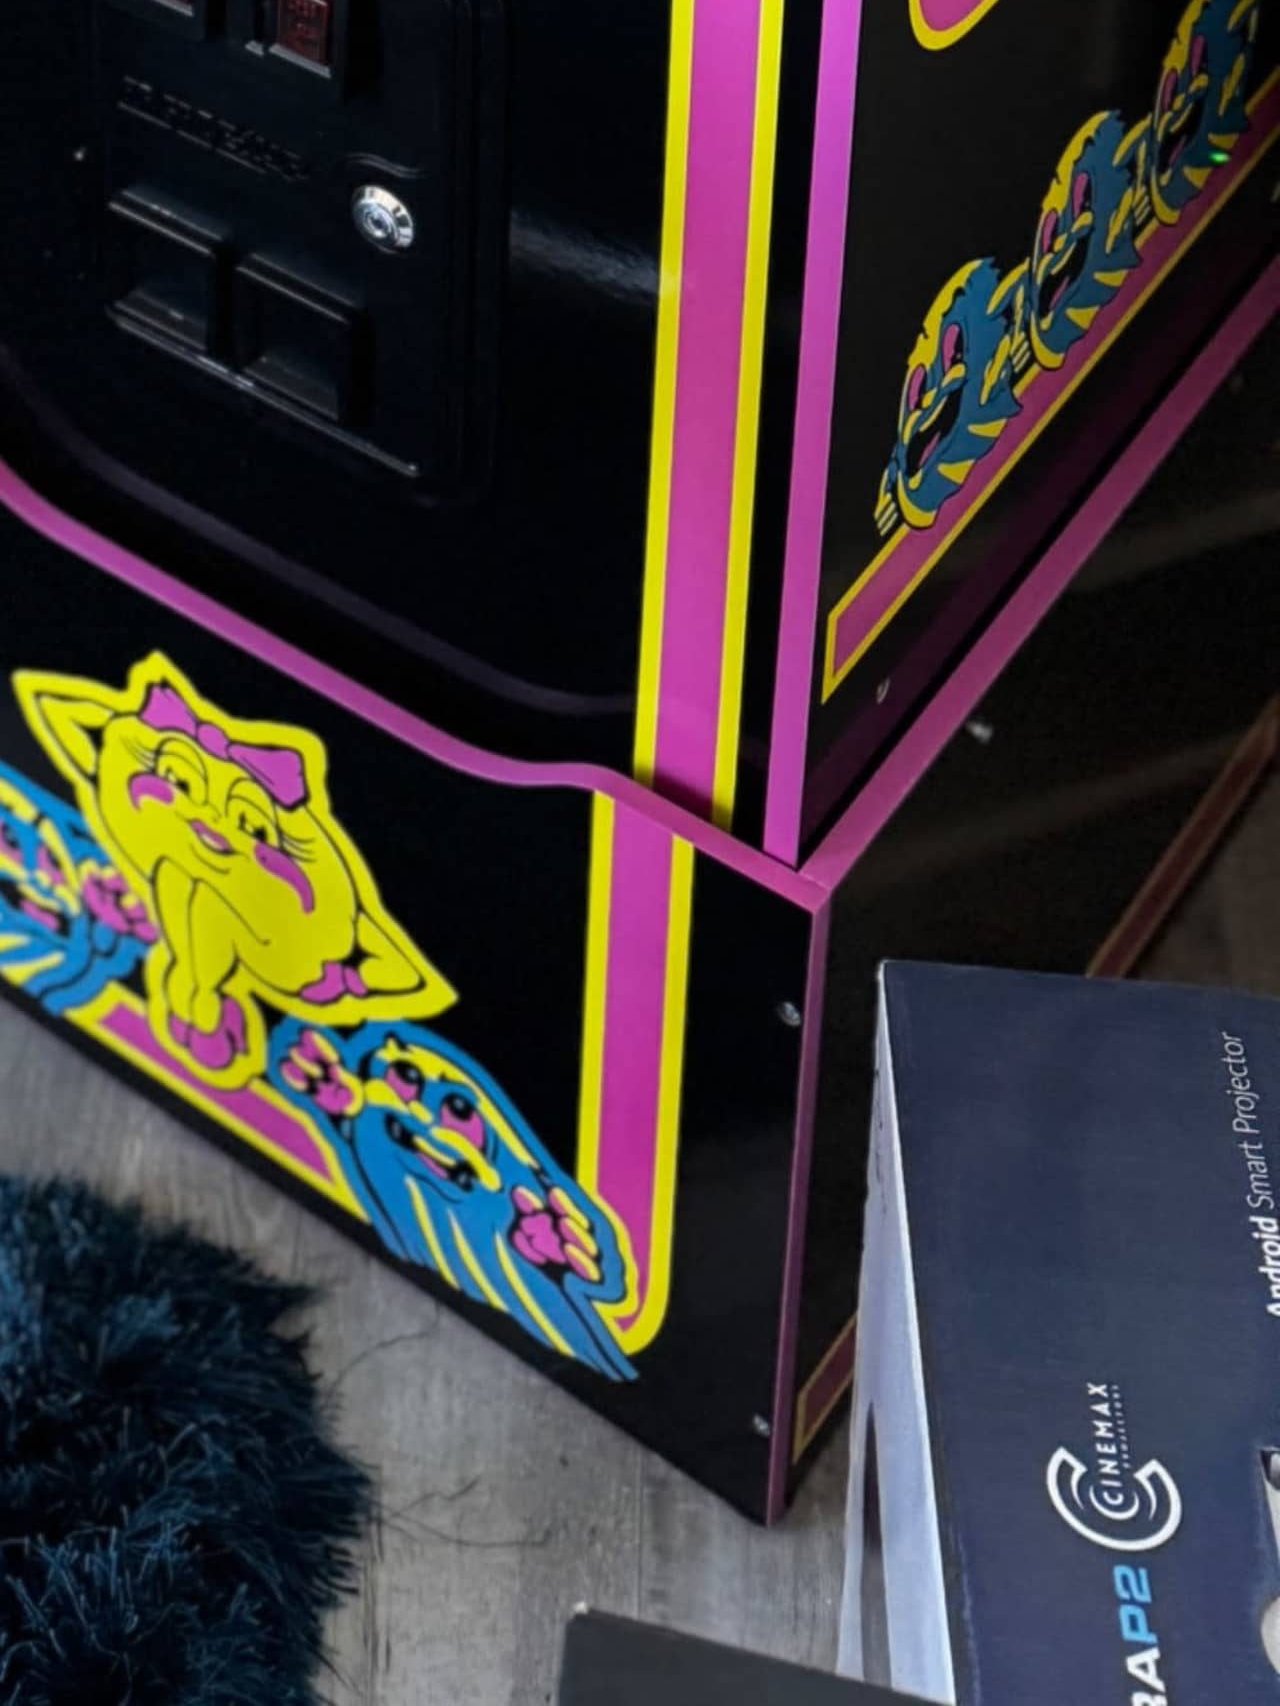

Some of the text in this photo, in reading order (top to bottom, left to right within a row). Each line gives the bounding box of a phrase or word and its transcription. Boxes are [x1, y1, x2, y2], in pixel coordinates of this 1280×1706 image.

[1222, 1031, 1260, 1135] Projector
[1238, 1140, 1274, 1210] Smart
[1087, 1383, 1124, 1506] CINEMAX
